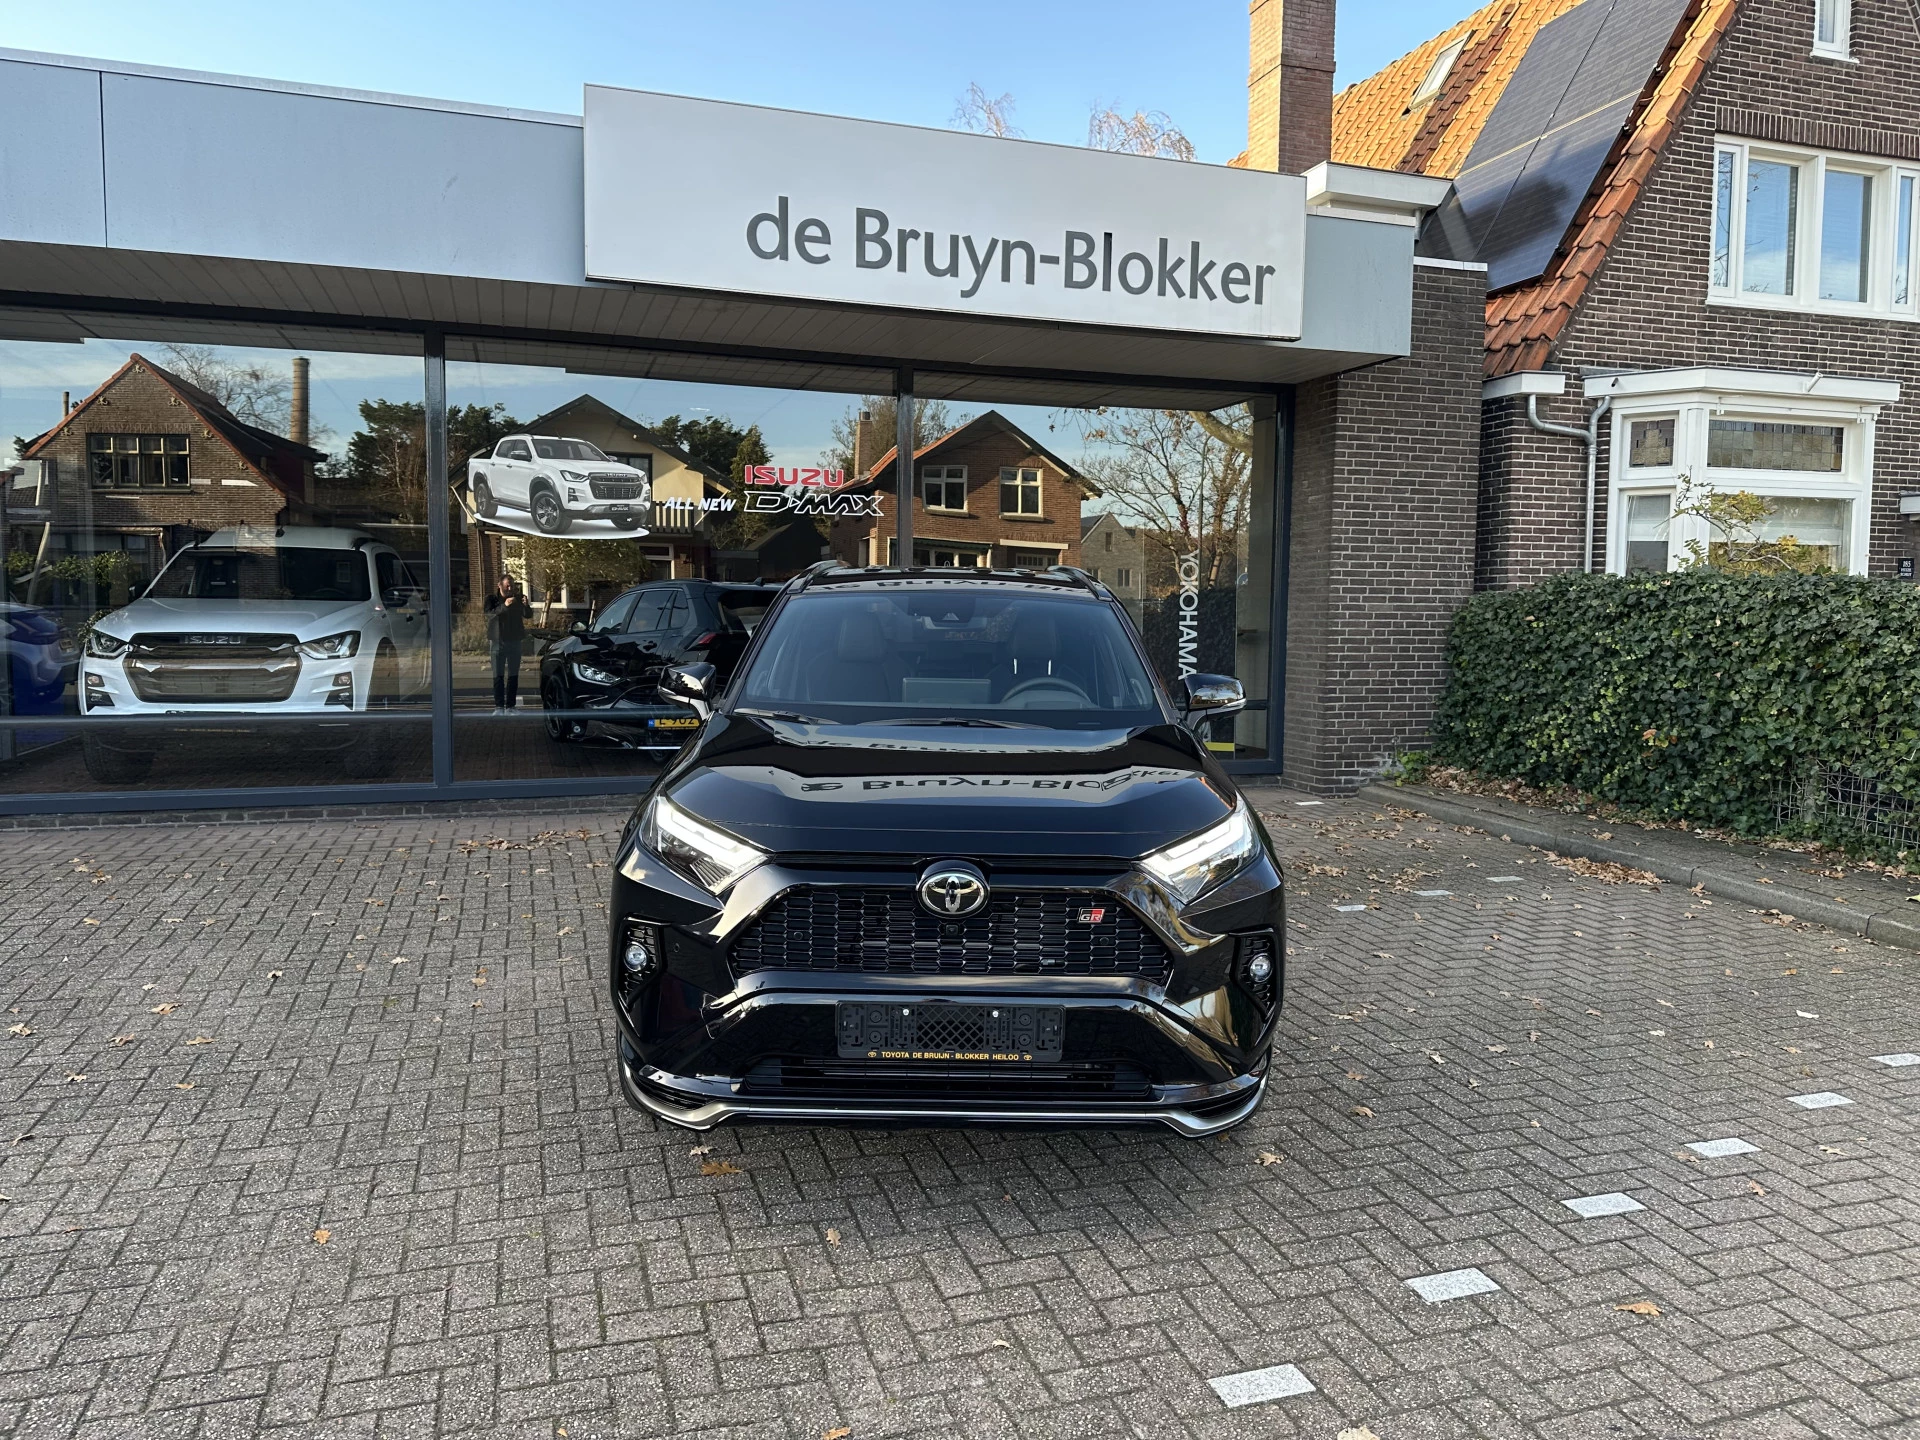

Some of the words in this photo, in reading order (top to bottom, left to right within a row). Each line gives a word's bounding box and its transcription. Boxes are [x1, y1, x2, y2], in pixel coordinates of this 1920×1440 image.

[746, 195, 832, 264] de
[855, 207, 1276, 305] Bruyn-Blokker
[744, 465, 844, 487] ISUZU
[664, 496, 694, 510] ALL
[697, 498, 737, 512] NEW
[1178, 549, 1200, 680] YOKOHAMA
[184, 635, 241, 645] ISUZU
[1080, 913, 1101, 921] GR
[881, 1051, 910, 1059] TOYOTA
[924, 1052, 950, 1060] BRUIJN
[955, 1052, 989, 1060] BLOKKER
[992, 1053, 1019, 1061] HEILOO
